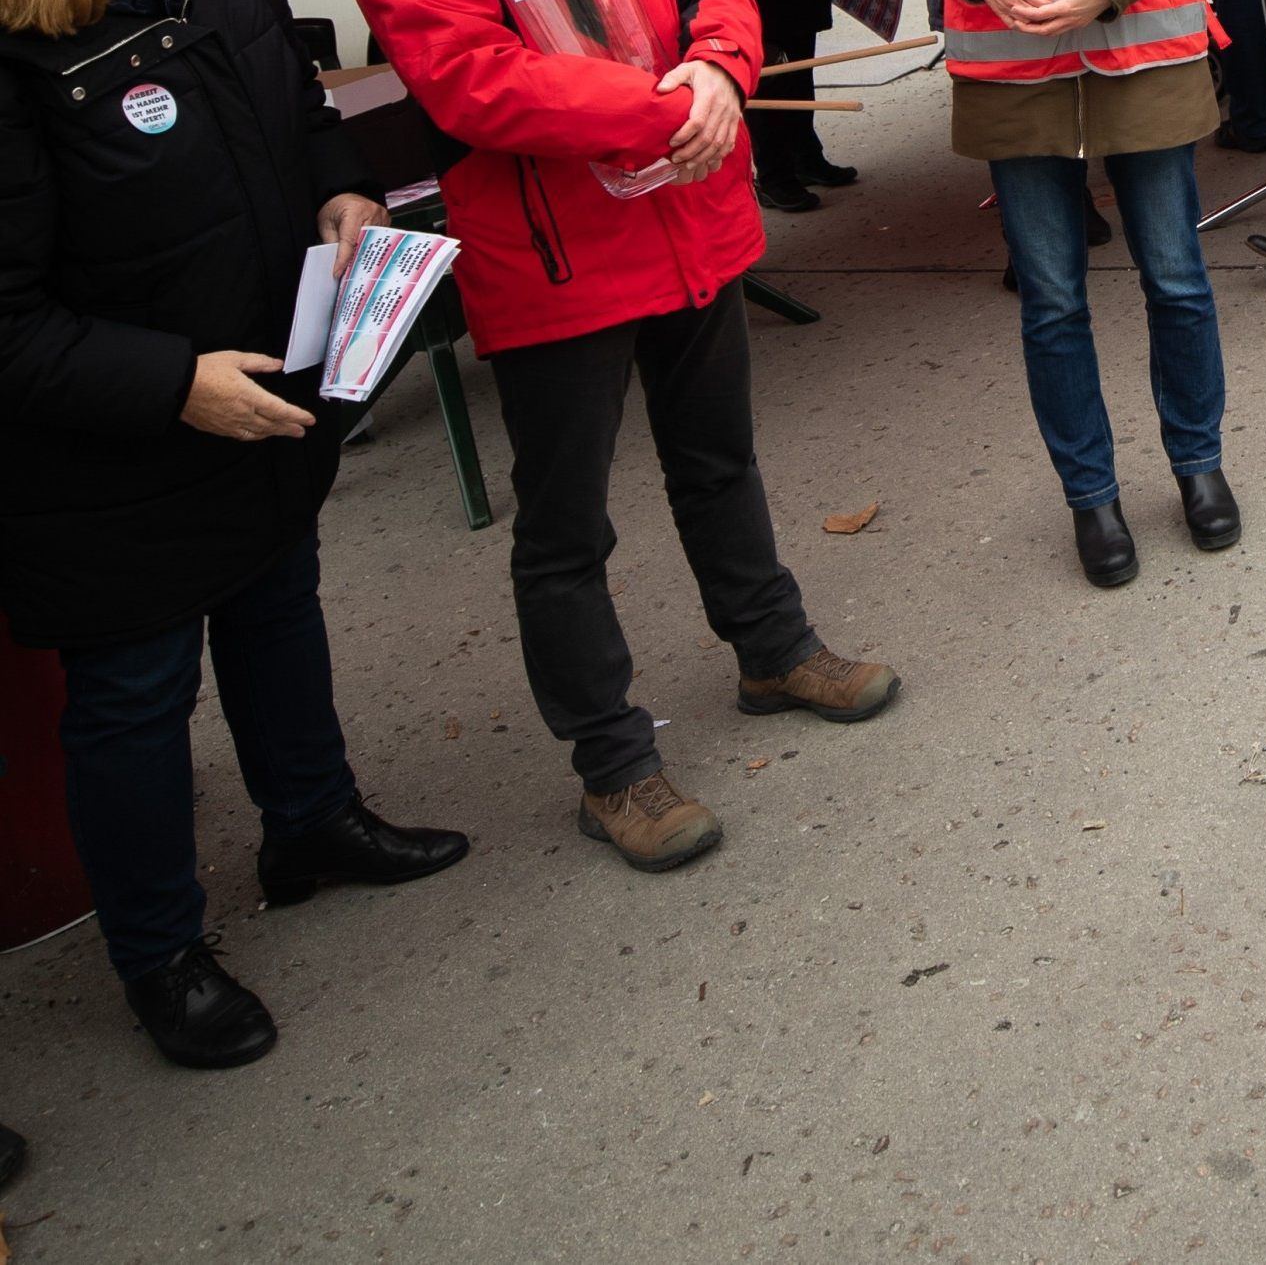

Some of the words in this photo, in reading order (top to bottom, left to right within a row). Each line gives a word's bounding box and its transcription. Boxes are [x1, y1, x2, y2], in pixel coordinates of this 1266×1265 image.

[129, 87, 158, 101] ARBEIT
[136, 94, 170, 108] HANDEL
[145, 104, 169, 115] MEHR
[140, 113, 166, 124] WERT!
